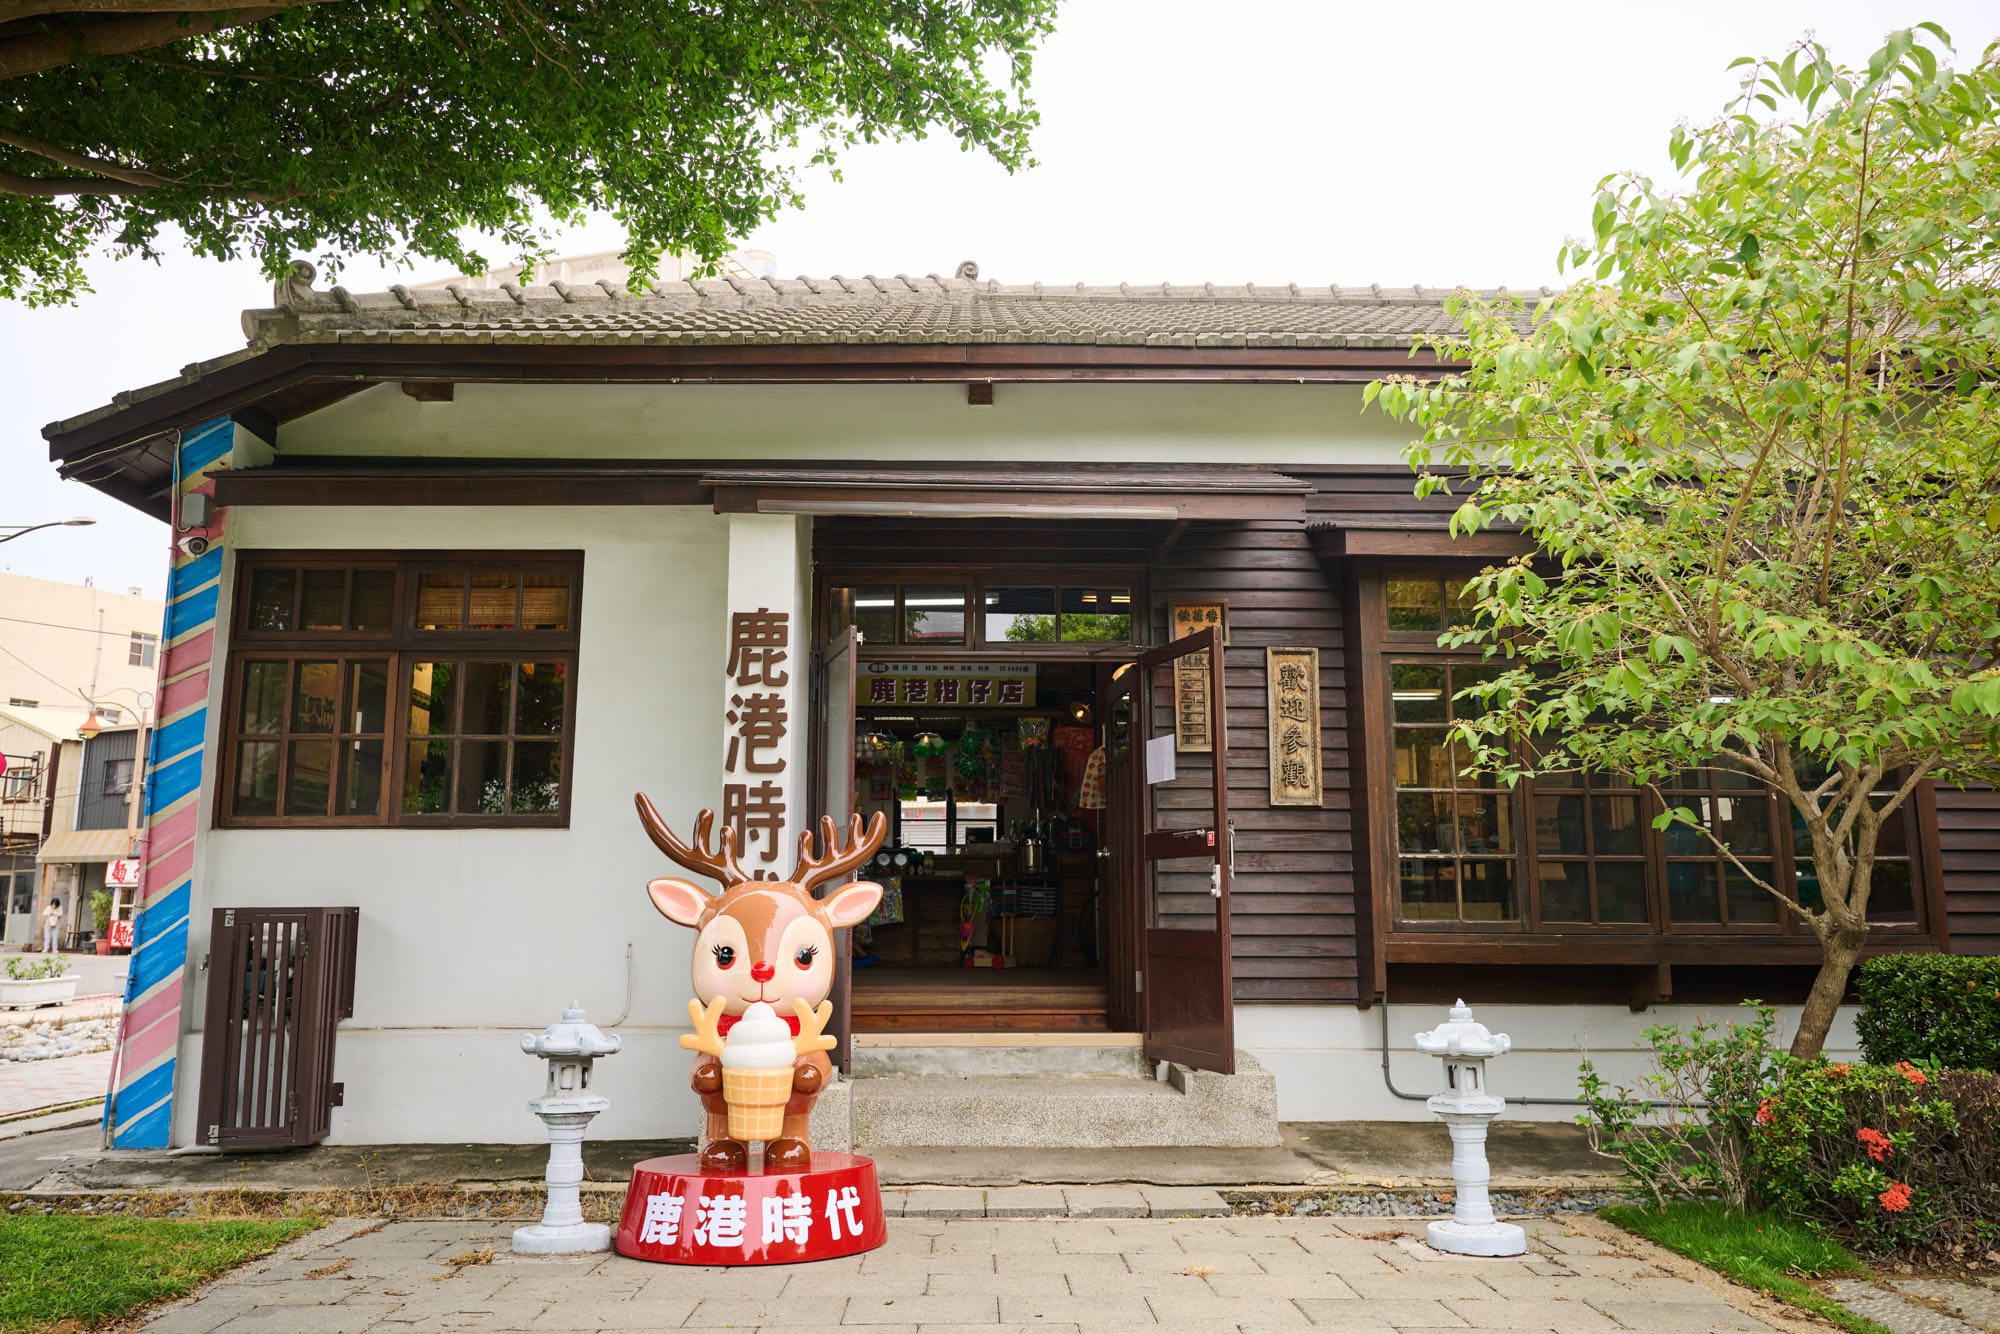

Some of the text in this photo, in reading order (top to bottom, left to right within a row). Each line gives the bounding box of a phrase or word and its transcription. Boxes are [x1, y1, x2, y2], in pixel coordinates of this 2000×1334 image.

[870, 678, 1025, 705] 鹿港柑仔店
[1279, 664, 1310, 788] 歡迎參觀
[723, 608, 789, 881] 鹿港時
[639, 1187, 864, 1247] 鹿港時代
